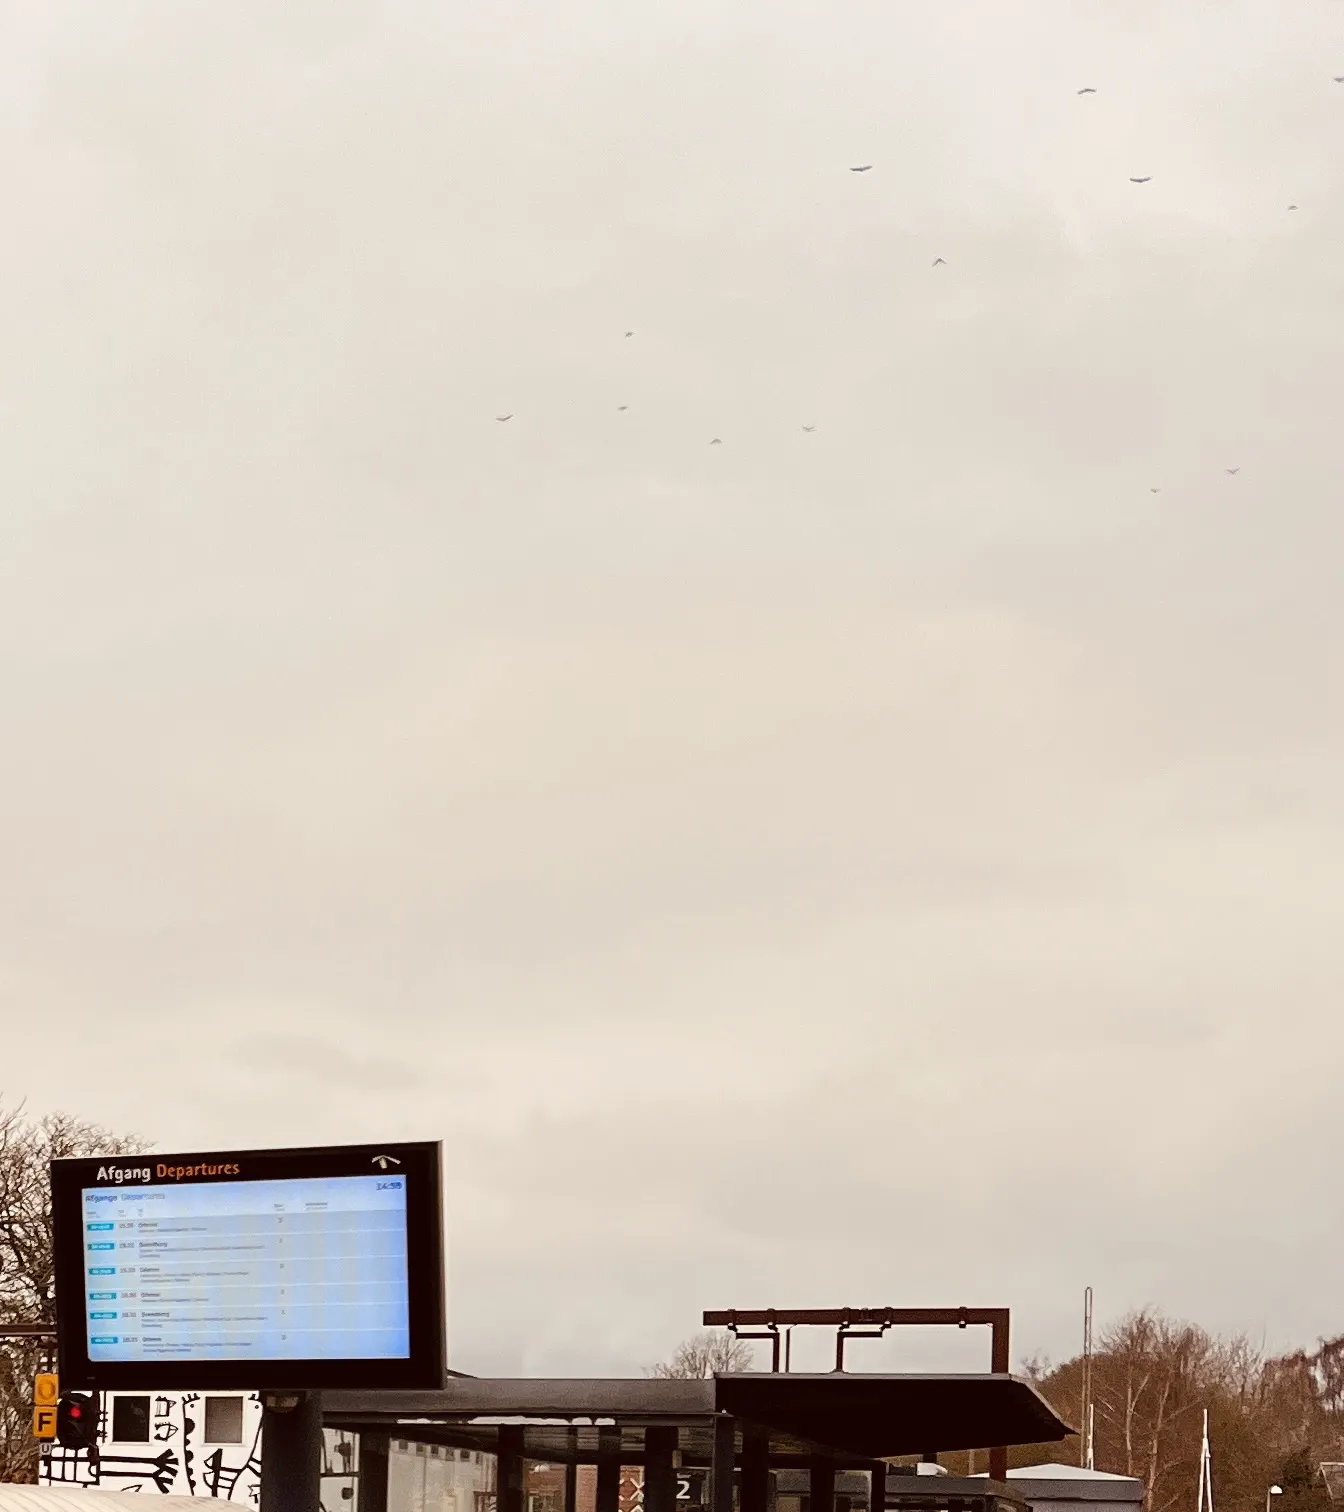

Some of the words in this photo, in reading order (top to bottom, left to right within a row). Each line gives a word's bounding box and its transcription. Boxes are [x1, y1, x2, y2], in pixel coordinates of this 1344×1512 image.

[96, 1165, 151, 1184] Afgang
[156, 1163, 240, 1180] Departures
[38, 1412, 53, 1432] F
[41, 1444, 50, 1454] U
[675, 1480, 691, 1499] 2
